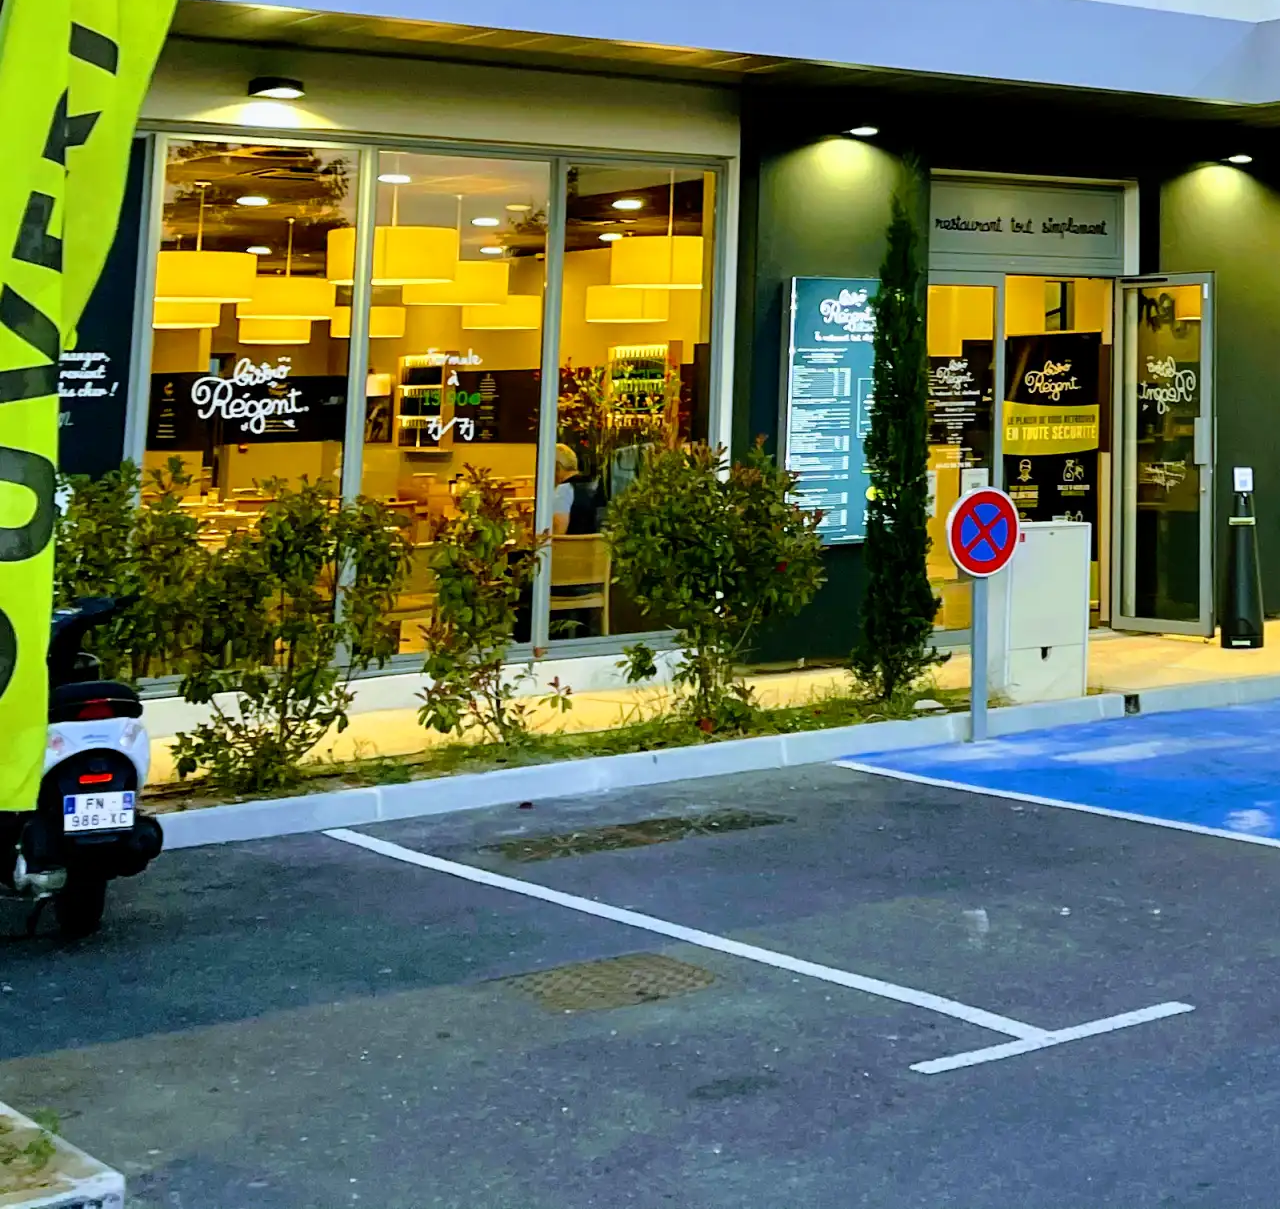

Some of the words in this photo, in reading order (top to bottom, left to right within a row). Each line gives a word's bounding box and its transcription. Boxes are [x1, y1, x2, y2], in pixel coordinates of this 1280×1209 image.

[935, 215, 1002, 233] restaurant
[1011, 217, 1034, 234] tout
[1042, 217, 1107, 239] simplement
[233, 357, 291, 386] bistro
